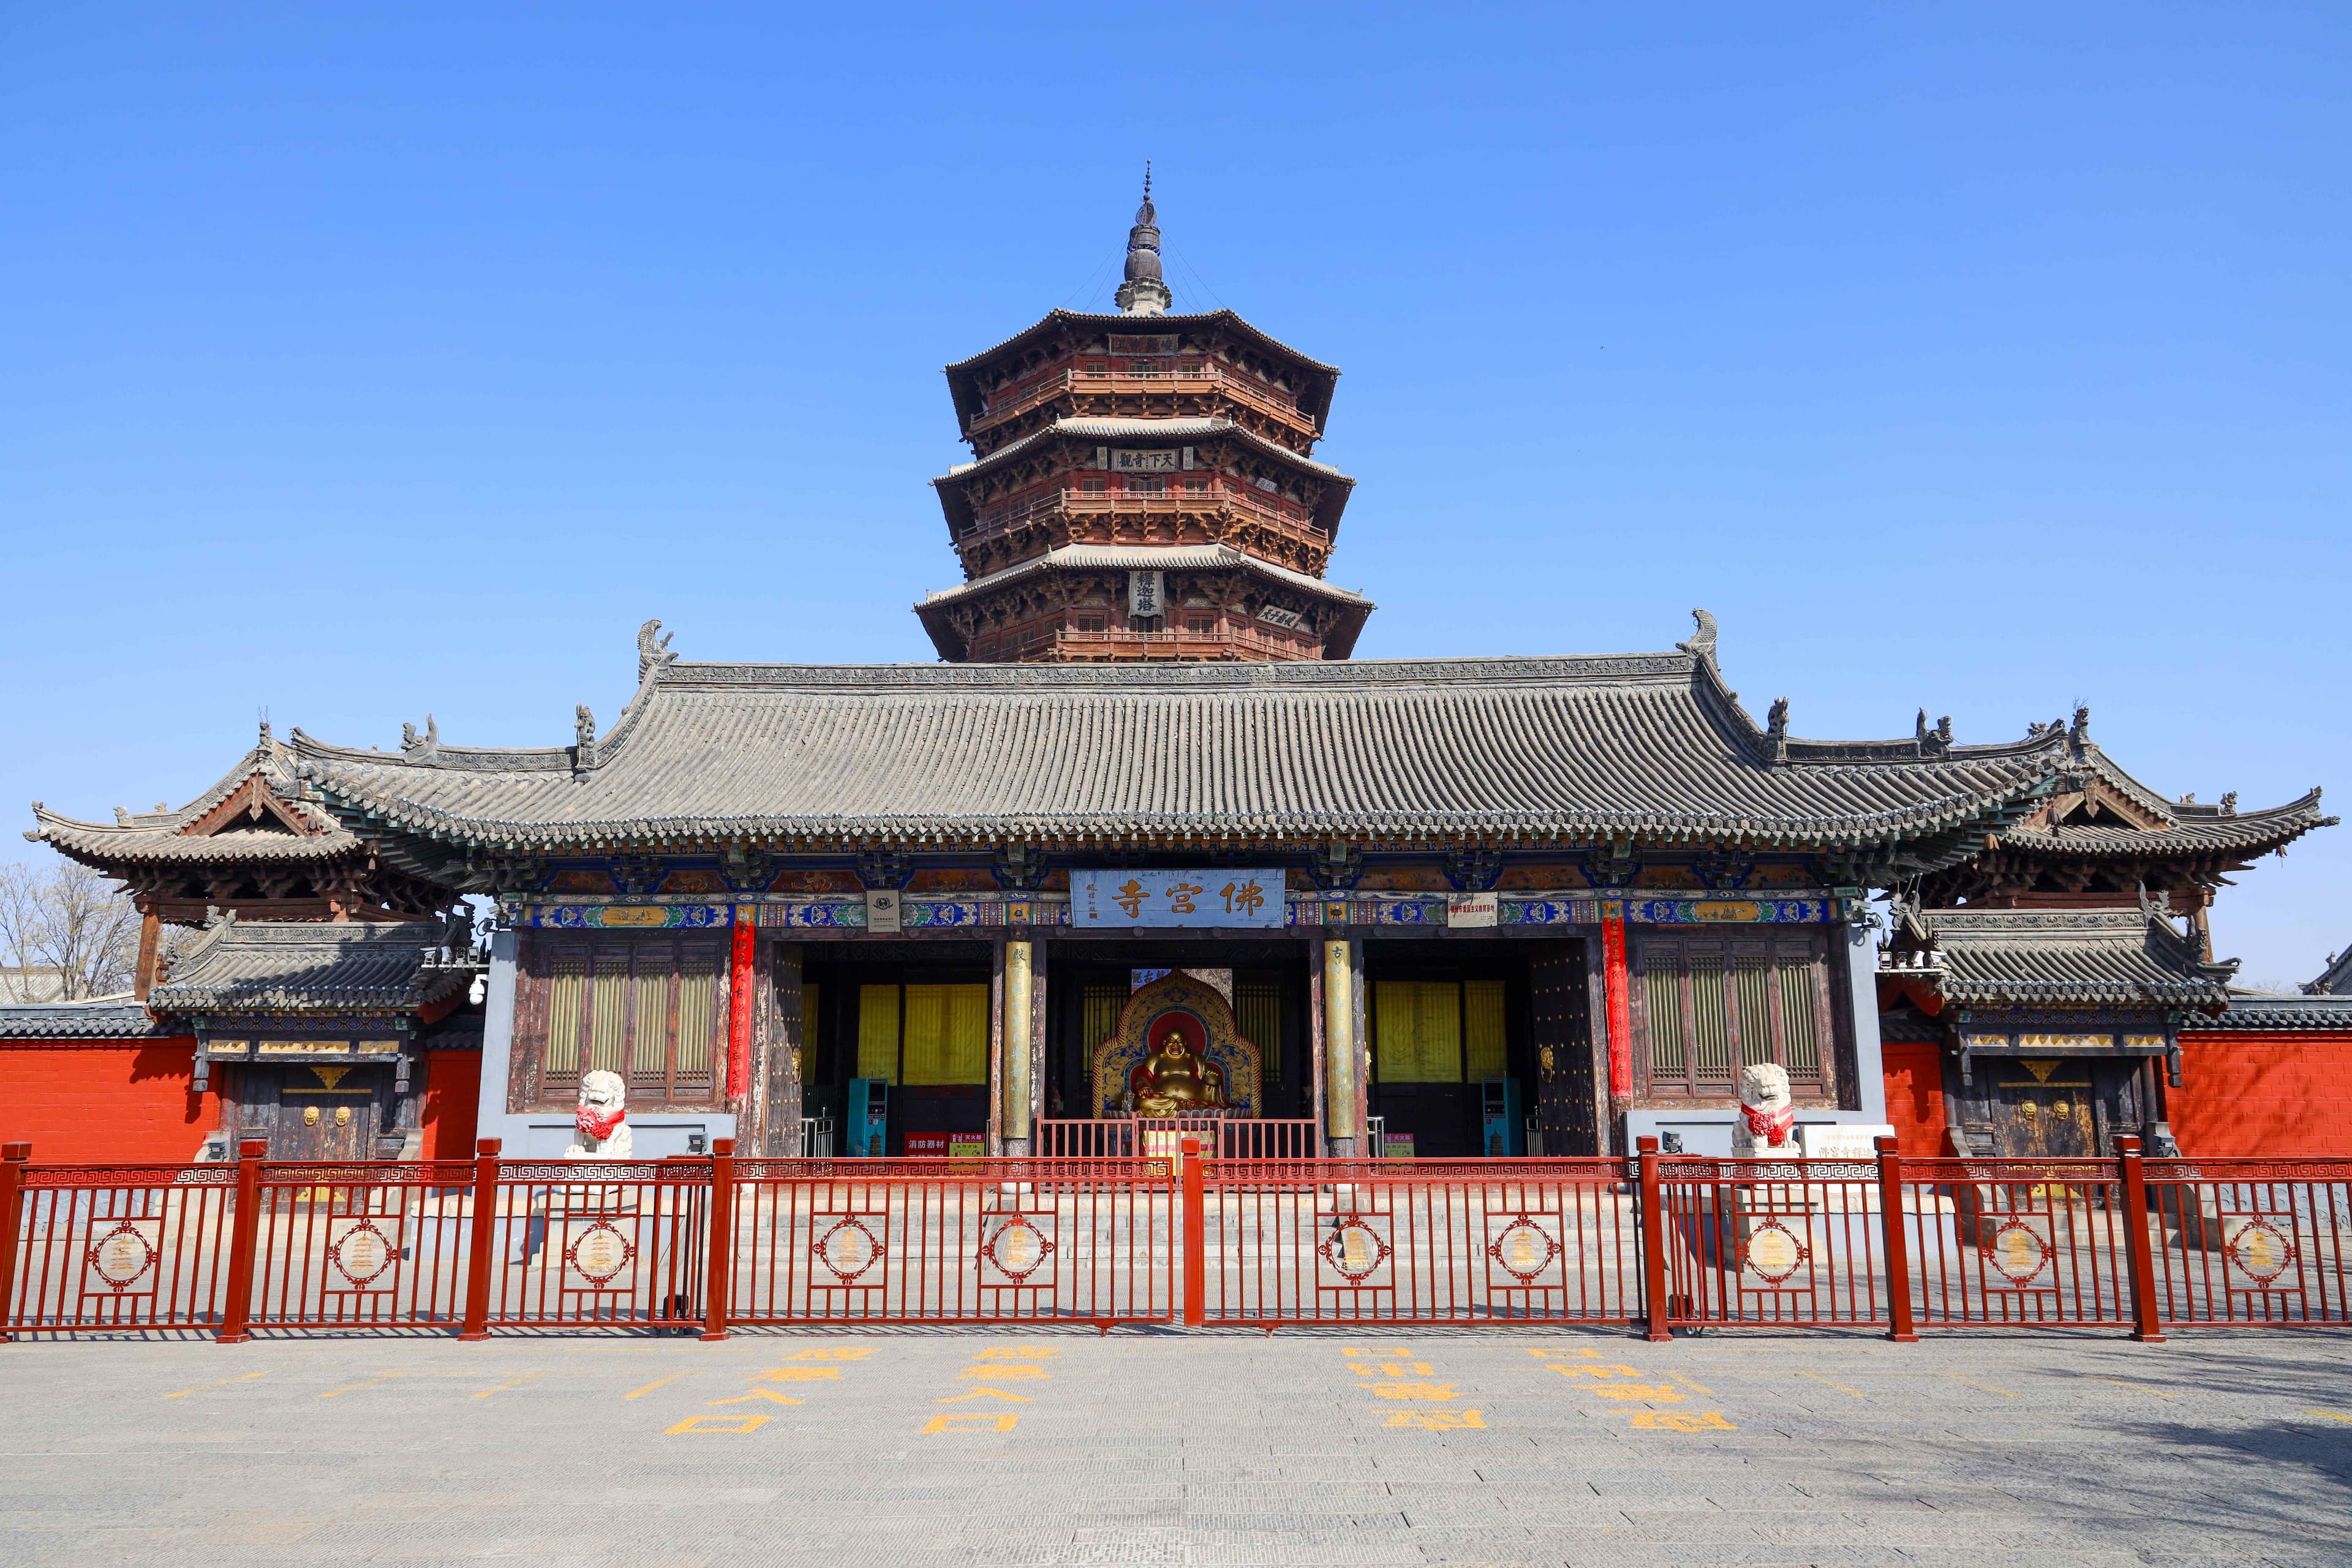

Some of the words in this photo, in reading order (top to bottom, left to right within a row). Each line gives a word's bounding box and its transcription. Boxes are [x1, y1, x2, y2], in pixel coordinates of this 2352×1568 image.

[1119, 452, 1174, 467] 天下奇觀
[1137, 571, 1156, 611] 釋迦塔
[909, 1140, 944, 1149] 消防器材
